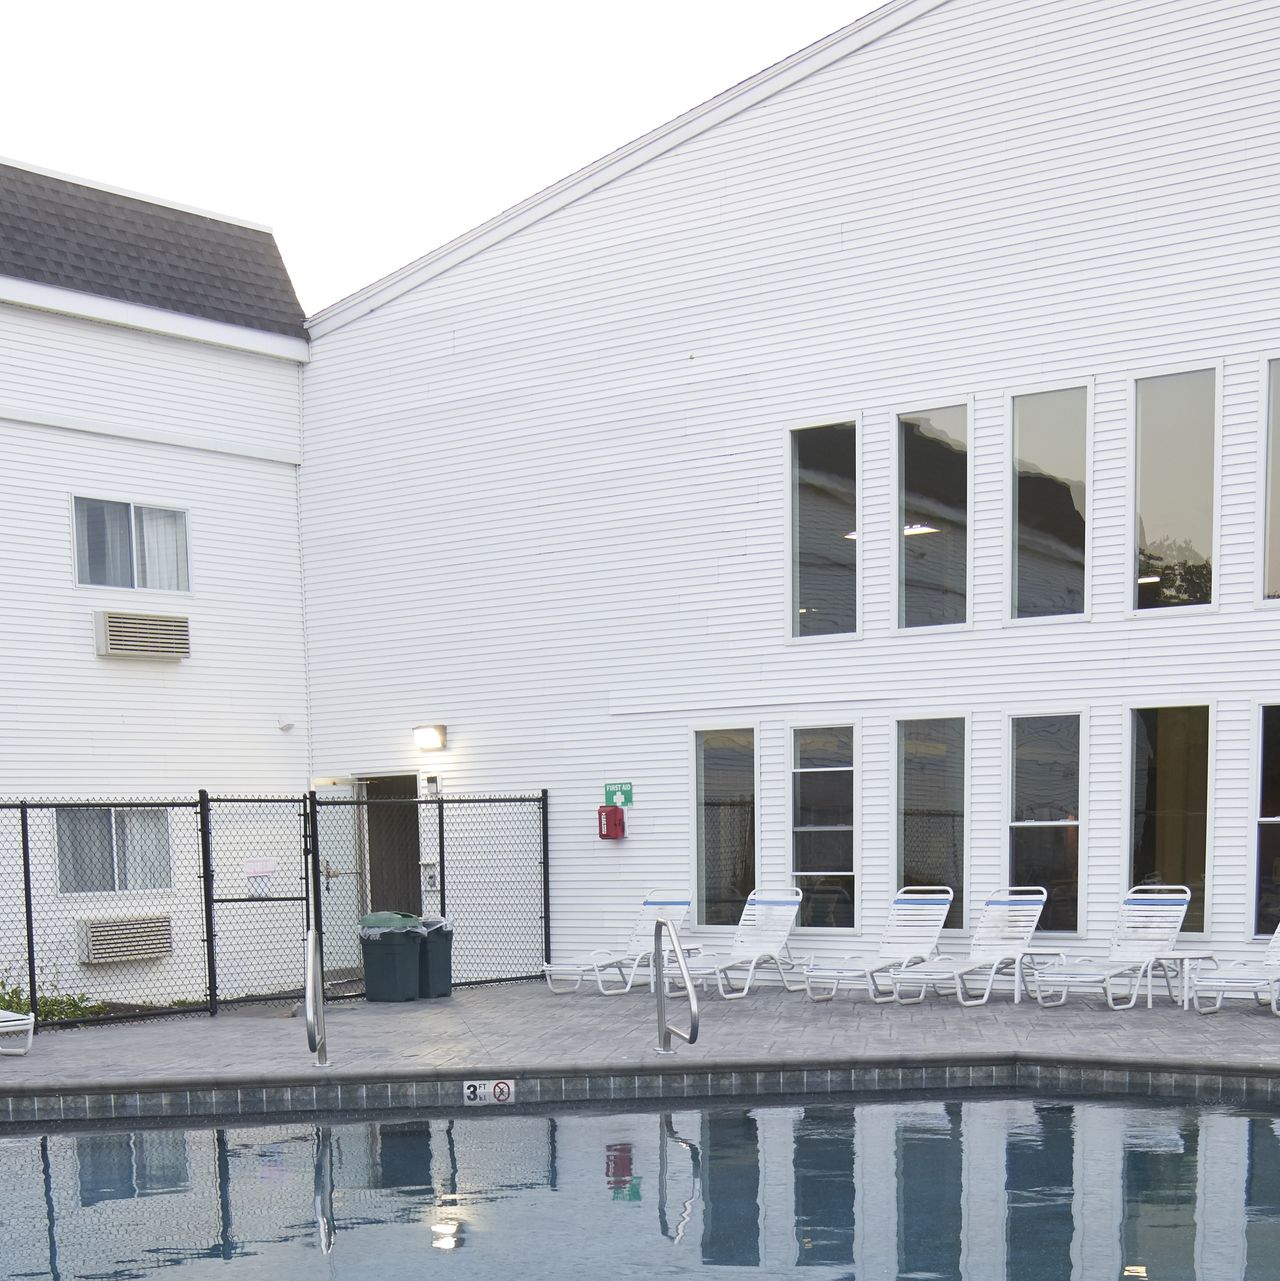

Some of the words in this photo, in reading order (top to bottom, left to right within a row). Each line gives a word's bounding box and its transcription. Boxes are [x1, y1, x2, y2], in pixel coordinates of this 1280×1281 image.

[606, 784, 621, 792] FIRST
[622, 783, 631, 791] AID
[466, 1084, 478, 1101] 3
